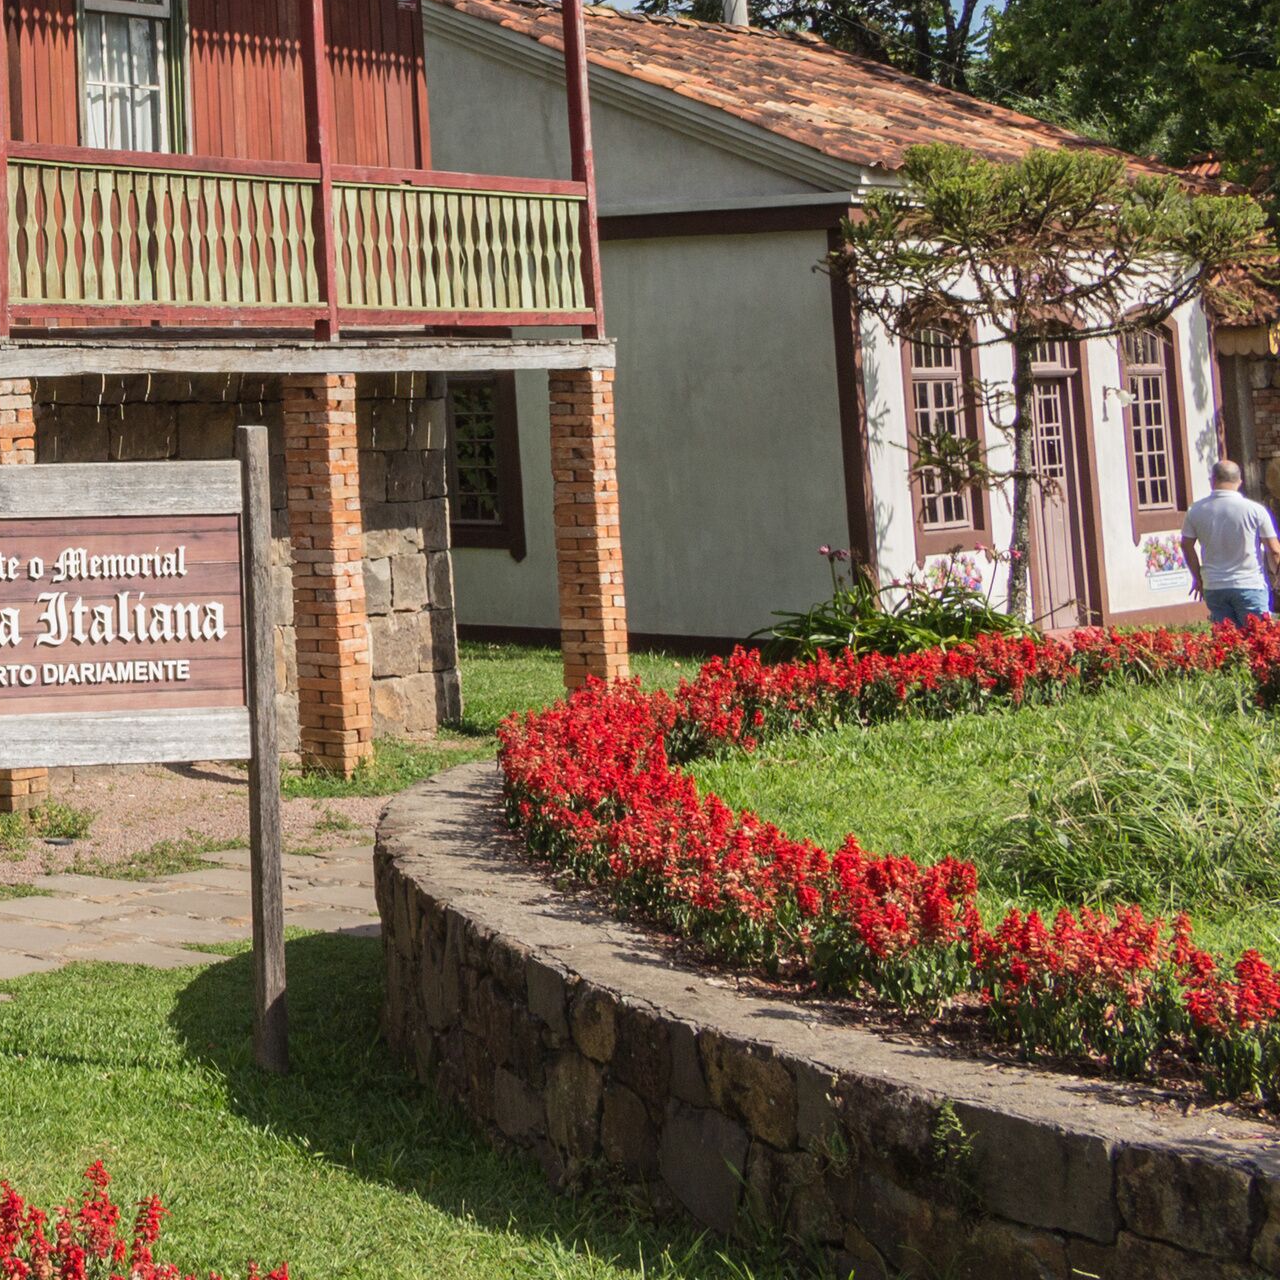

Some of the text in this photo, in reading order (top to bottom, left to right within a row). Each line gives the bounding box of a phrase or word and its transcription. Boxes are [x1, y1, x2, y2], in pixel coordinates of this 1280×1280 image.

[28, 557, 44, 581] o
[50, 545, 189, 584] Memorial
[34, 590, 228, 648] Italiana
[42, 659, 191, 685] DIARIAMENTE
